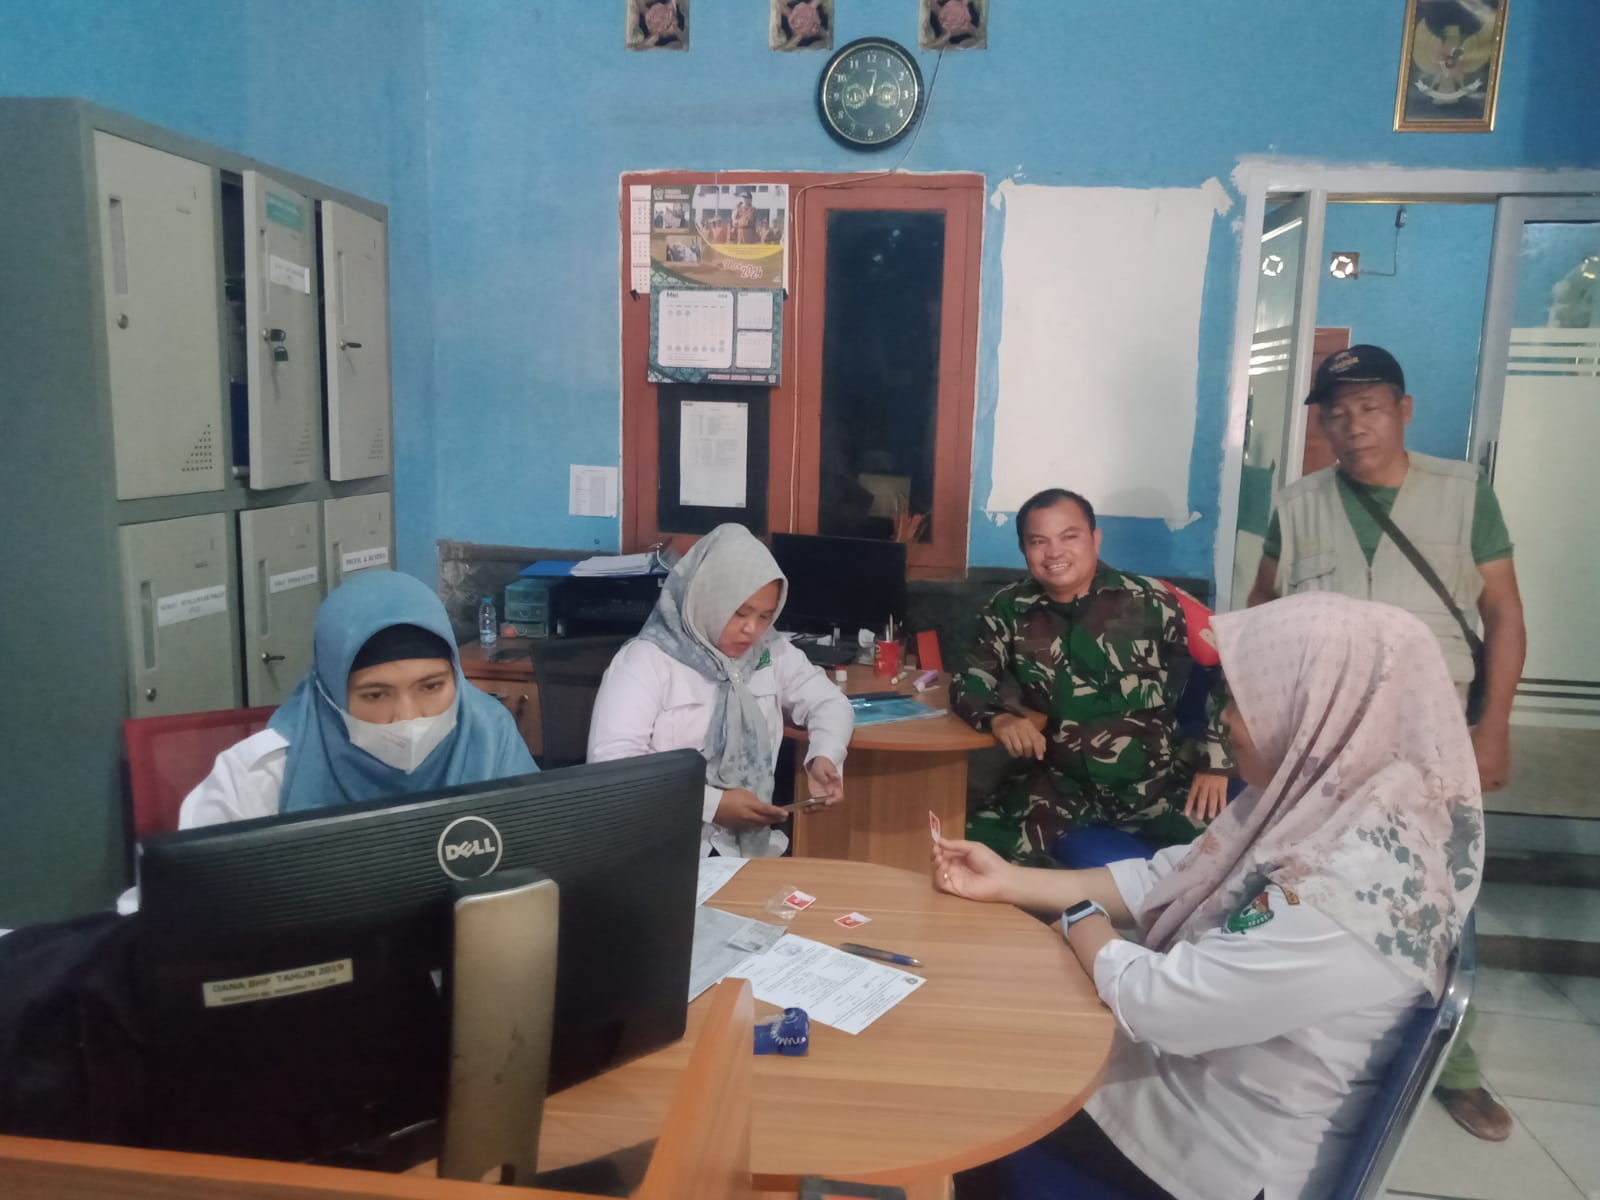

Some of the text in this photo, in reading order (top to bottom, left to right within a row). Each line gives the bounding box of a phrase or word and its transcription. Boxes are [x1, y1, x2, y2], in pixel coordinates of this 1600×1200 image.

[866, 54, 877, 63] 12
[849, 60, 859, 69] 11
[445, 838, 496, 861] DELL
